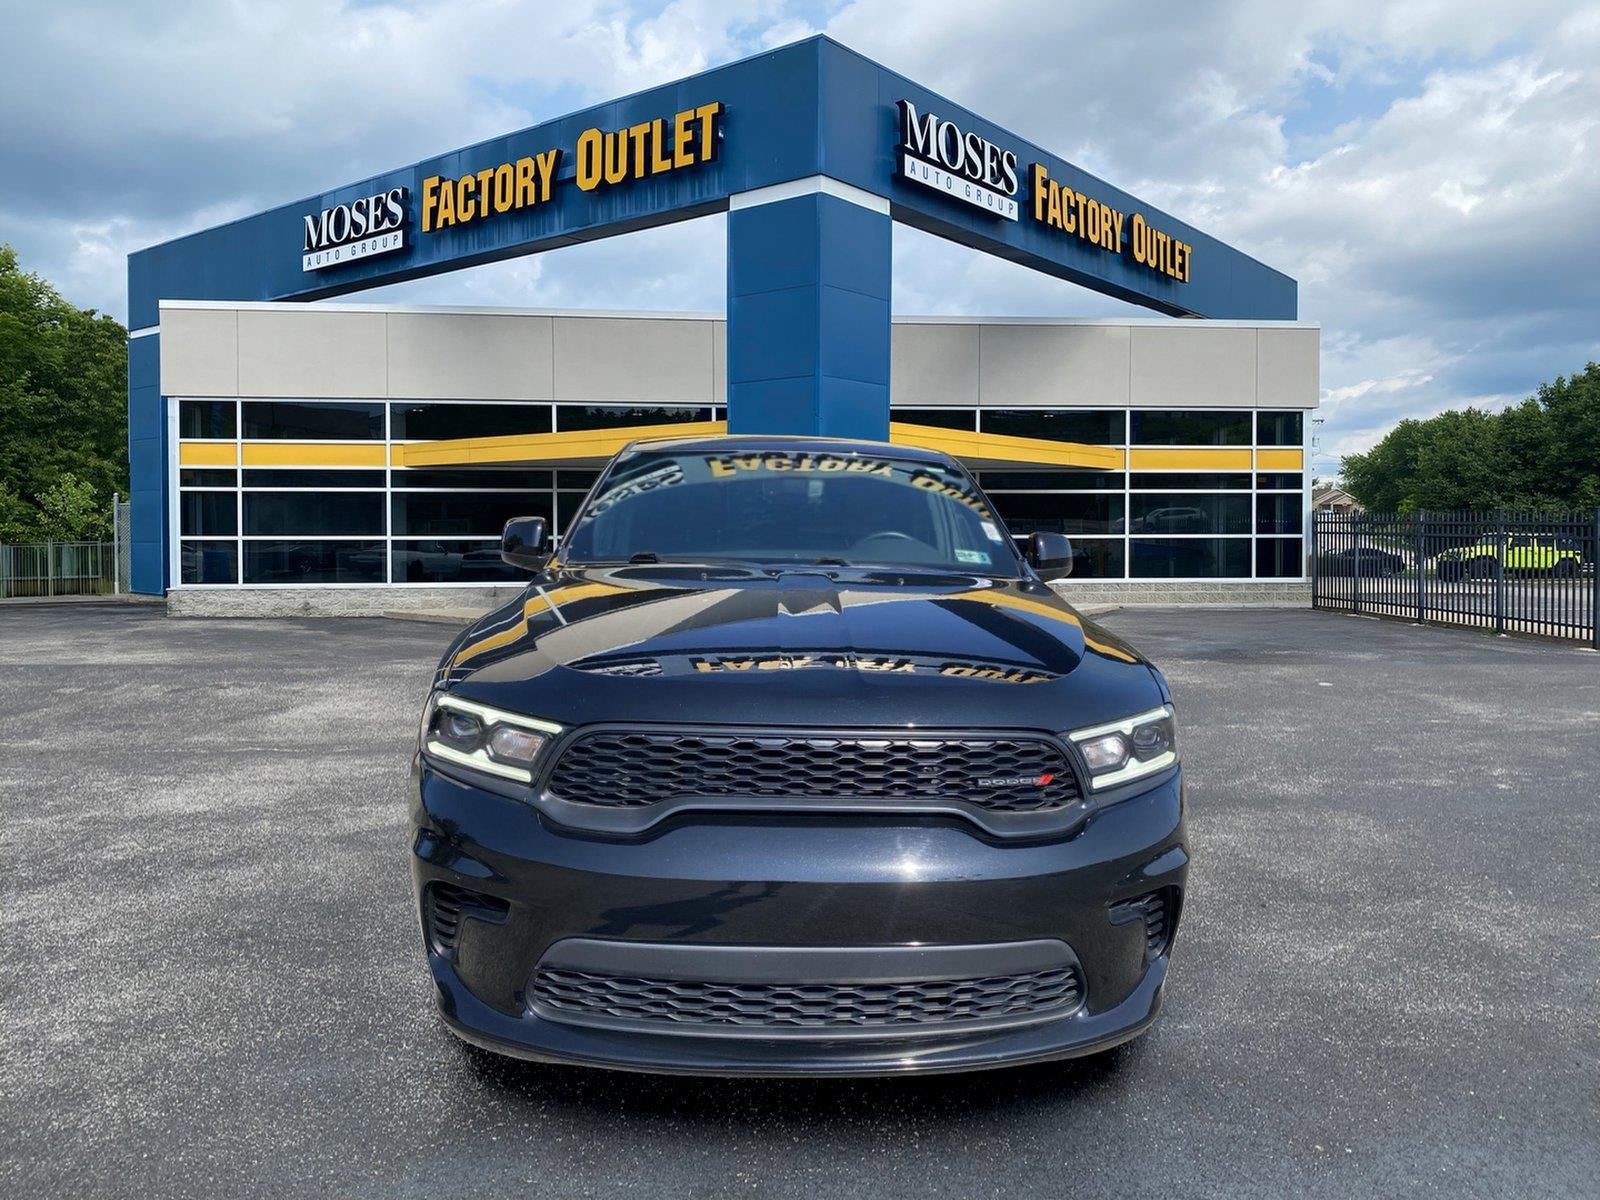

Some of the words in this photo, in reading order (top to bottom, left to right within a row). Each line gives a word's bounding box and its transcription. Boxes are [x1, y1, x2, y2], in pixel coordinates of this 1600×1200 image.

[422, 148, 558, 233] FACTORY
[576, 101, 720, 191] OUTLET
[904, 99, 1018, 196] MOSES
[303, 188, 403, 251] MOSES
[909, 161, 953, 190] AUTO
[965, 184, 1015, 215] GROUP
[1034, 163, 1124, 254] FACTORY
[1131, 213, 1192, 283] OUTLET
[307, 250, 340, 267] AUTO
[350, 234, 399, 256] GROUP
